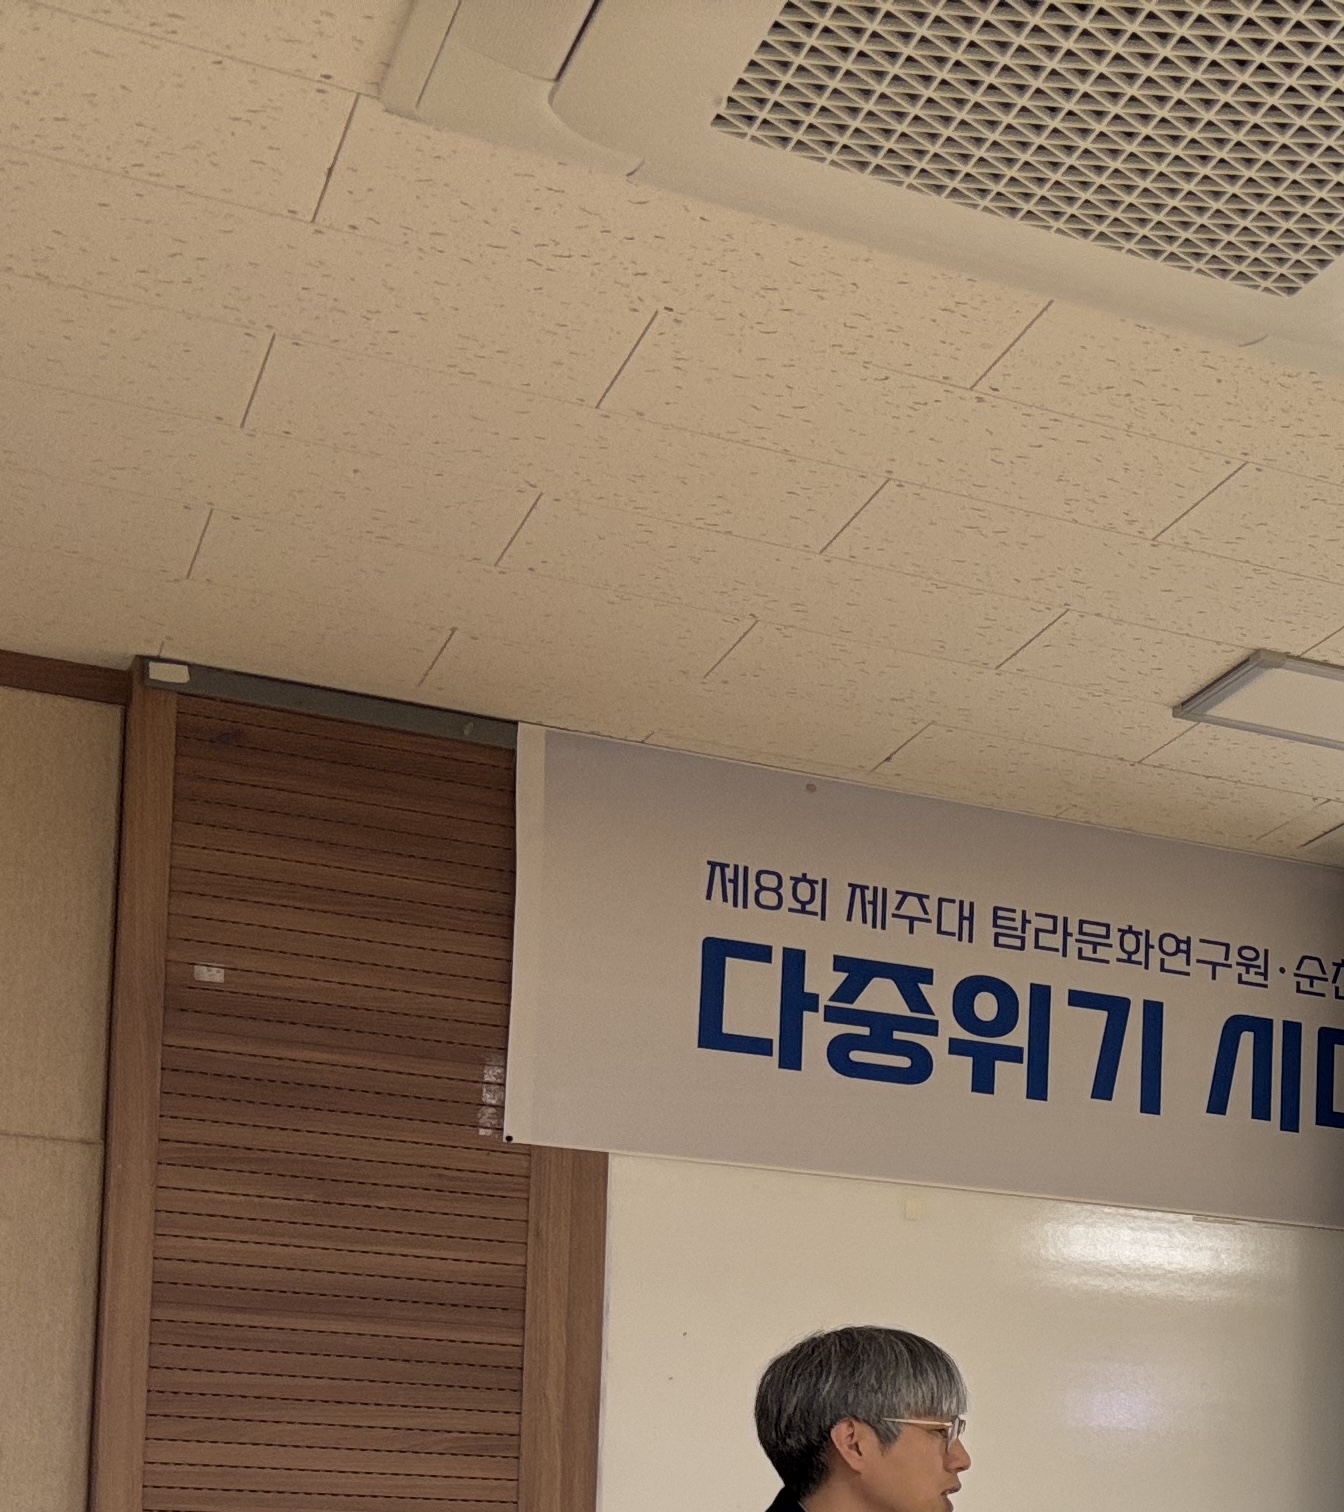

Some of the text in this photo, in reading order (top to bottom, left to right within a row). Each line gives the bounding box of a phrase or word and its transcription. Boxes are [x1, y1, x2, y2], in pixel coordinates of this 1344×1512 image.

[706, 860, 827, 921] 제8회
[846, 882, 975, 943] 제주대
[697, 936, 1164, 1116] 다중위기
